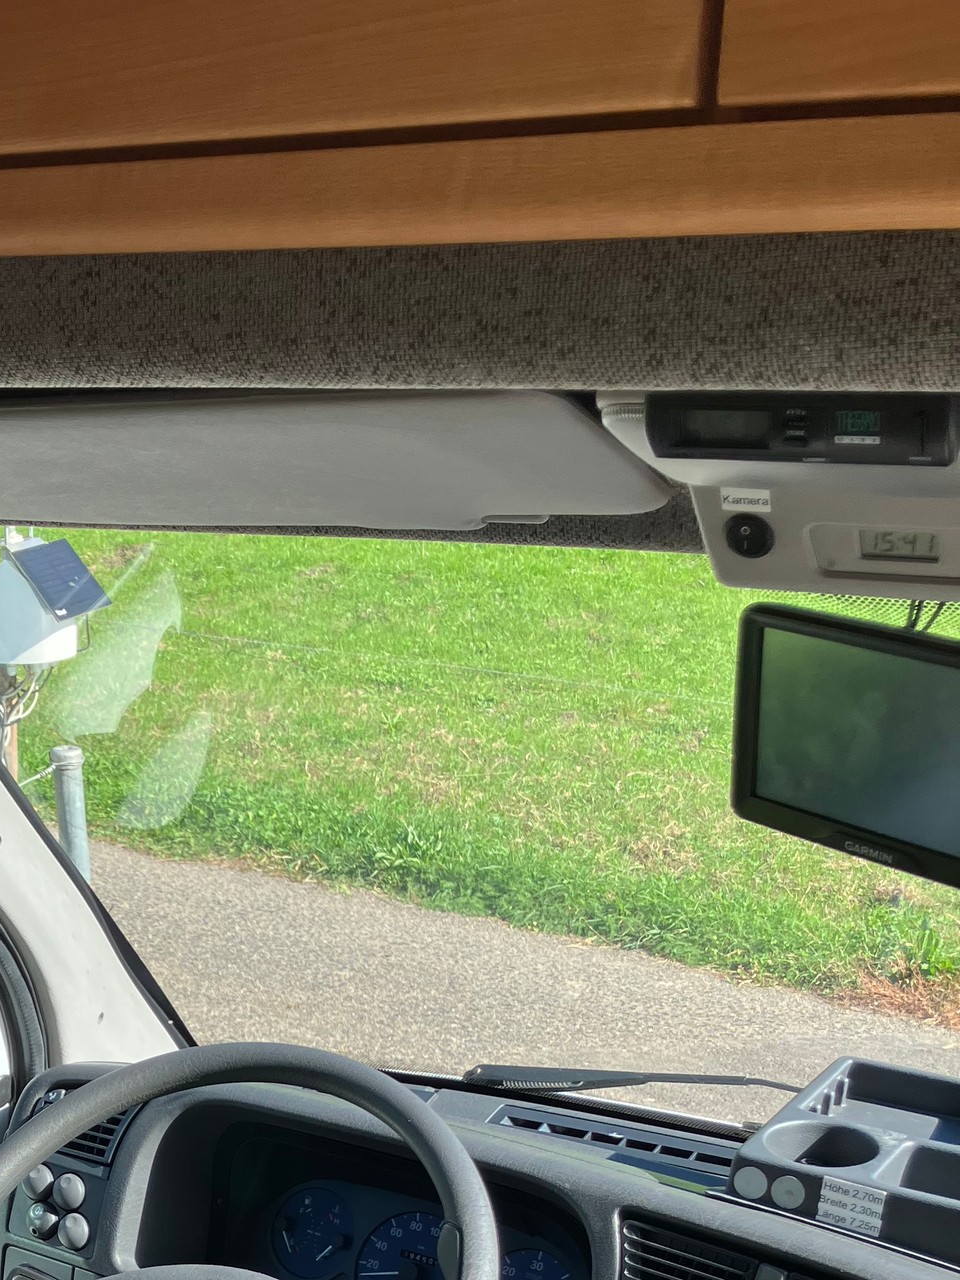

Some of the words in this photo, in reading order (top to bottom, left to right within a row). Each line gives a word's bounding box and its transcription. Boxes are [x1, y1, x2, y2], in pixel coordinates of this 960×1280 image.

[722, 495, 769, 506] Kamera
[844, 841, 894, 864] GARMIN
[824, 1182, 849, 1196] Höhe
[852, 1189, 883, 1205] 2.70m
[819, 1194, 847, 1209] Breite
[850, 1203, 880, 1219] 2.30m
[409, 1221, 422, 1231] 80
[849, 1217, 879, 1233] 7.25m
[390, 1228, 402, 1238] 60
[430, 1227, 441, 1237] 10
[375, 1240, 388, 1251] 40
[366, 1259, 379, 1269] 20
[530, 1260, 543, 1271] 30
[502, 1266, 515, 1276] 20
